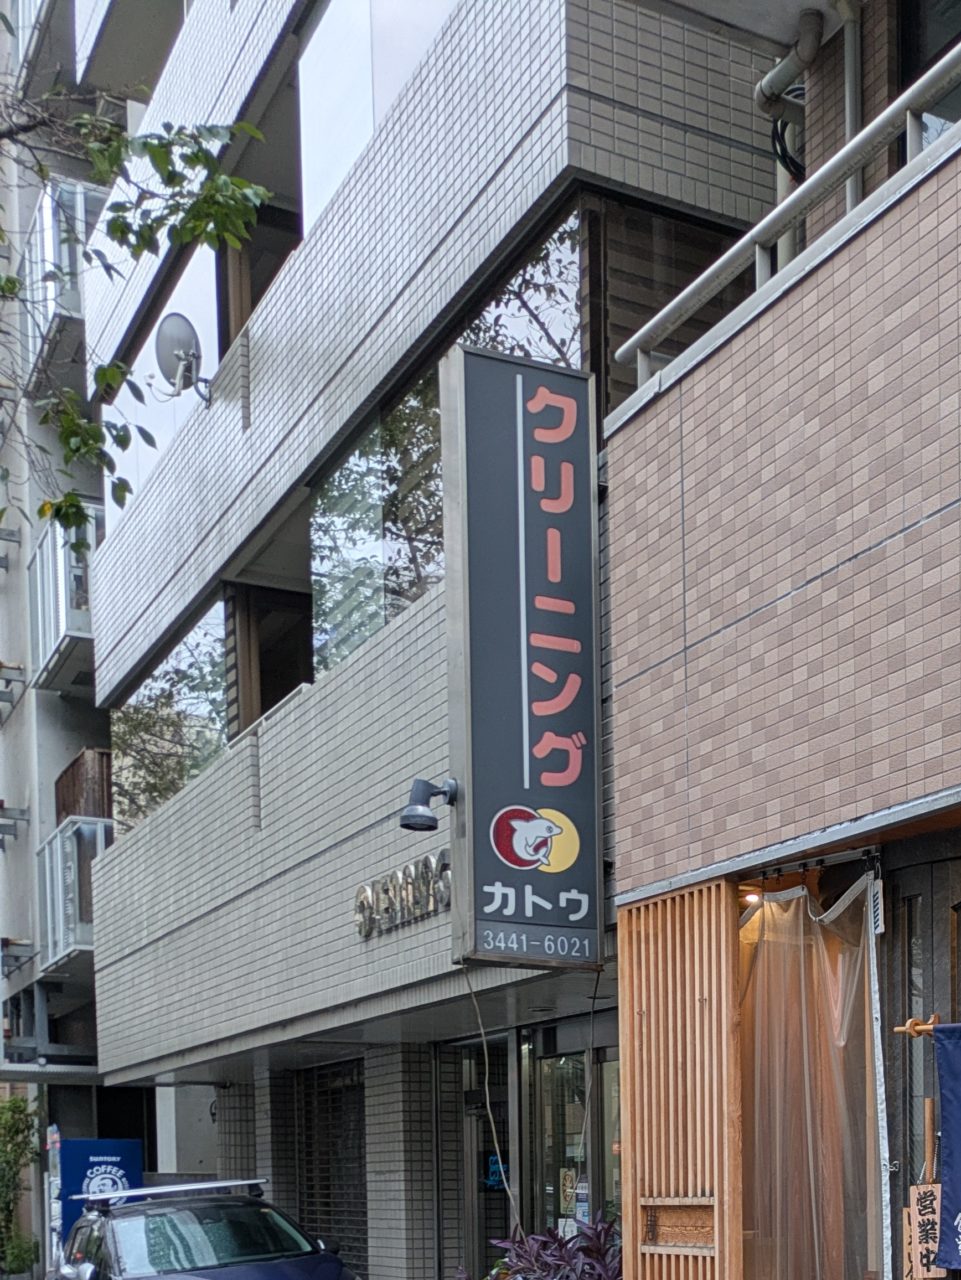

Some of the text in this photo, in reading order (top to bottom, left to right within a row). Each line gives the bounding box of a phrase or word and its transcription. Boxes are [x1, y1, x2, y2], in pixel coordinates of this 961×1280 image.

[526, 385, 589, 788] クリーニング
[482, 881, 590, 922] カトウ
[483, 929, 591, 958] 3441-6021
[86, 1165, 126, 1178] COFFEE
[916, 1189, 938, 1273] 営業中
